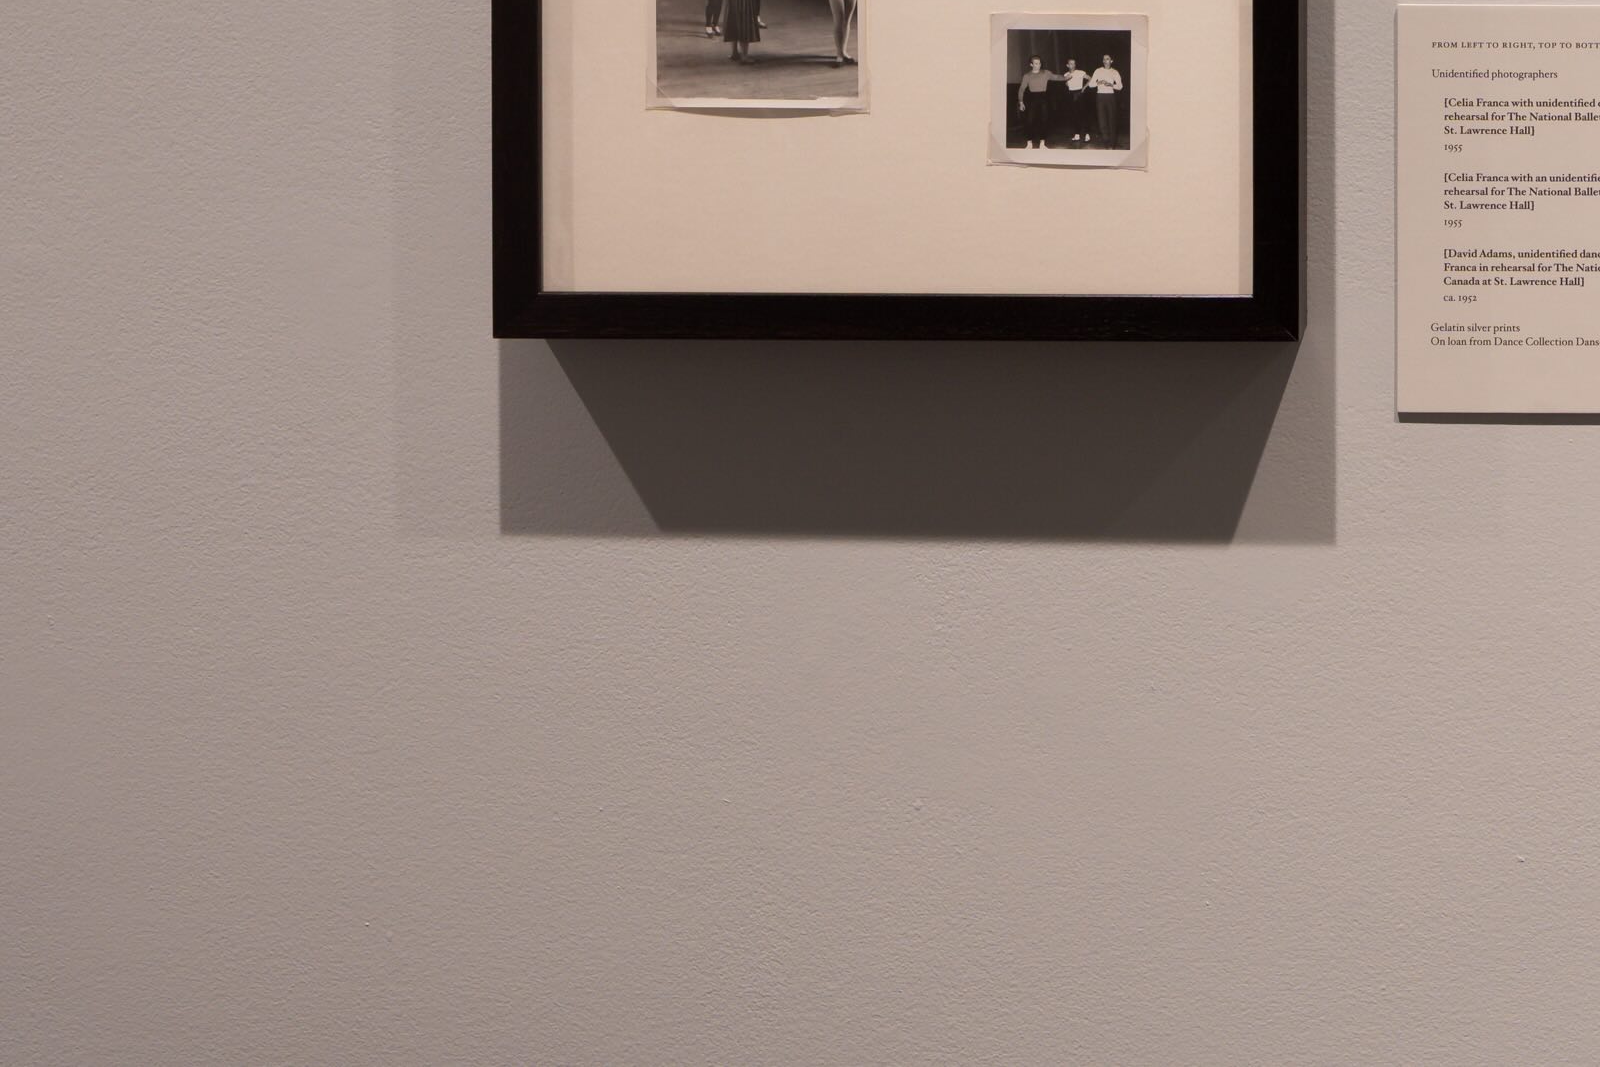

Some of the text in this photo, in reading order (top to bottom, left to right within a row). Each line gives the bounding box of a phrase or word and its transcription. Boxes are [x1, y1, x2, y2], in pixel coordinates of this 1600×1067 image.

[1431, 41, 1458, 49] FROM
[1461, 41, 1485, 49] LEFT
[1485, 41, 1500, 49] TO
[1502, 41, 1536, 50] RIGHT,
[1537, 41, 1557, 49] TOP
[1431, 68, 1558, 82] Unidentified photographers
[1444, 97, 1475, 109] [Celia
[1476, 97, 1510, 108] Franca
[1510, 97, 1534, 108] with
[1535, 97, 1596, 108] unidentified
[1443, 111, 1489, 122] rehearsal
[1490, 111, 1507, 122] for
[1506, 111, 1528, 122] The
[1528, 111, 1573, 122] National
[1443, 125, 1535, 137] St. Lawrence Hall]
[1444, 143, 1464, 153] 1955
[1443, 172, 1474, 184] [Celia
[1475, 172, 1510, 183] Franca
[1510, 172, 1534, 183] with
[1534, 175, 1548, 183] an
[1443, 186, 1489, 196] rehearsal
[1490, 186, 1506, 196] for
[1506, 186, 1527, 197] The
[1528, 186, 1572, 197] National
[1443, 200, 1535, 212] St. Lawrence Hall]
[1444, 219, 1463, 229] 1955
[1443, 248, 1478, 260] [David
[1478, 248, 1516, 260] Adams,
[1517, 248, 1578, 259] unidentified
[1443, 262, 1478, 272] Franca
[1478, 262, 1490, 272] in
[1490, 262, 1536, 273] rehearsal
[1536, 262, 1553, 273] for
[1552, 262, 1574, 273] The
[1442, 276, 1585, 288] Canada at St. Lawrence Hall]
[1458, 294, 1478, 304] 1952
[1430, 322, 1521, 335] Gelatin silver prints
[1430, 335, 1446, 346] On
[1447, 336, 1468, 346] loan
[1468, 336, 1492, 346] from
[1493, 336, 1524, 347] Dance
[1525, 336, 1574, 347] Collection
